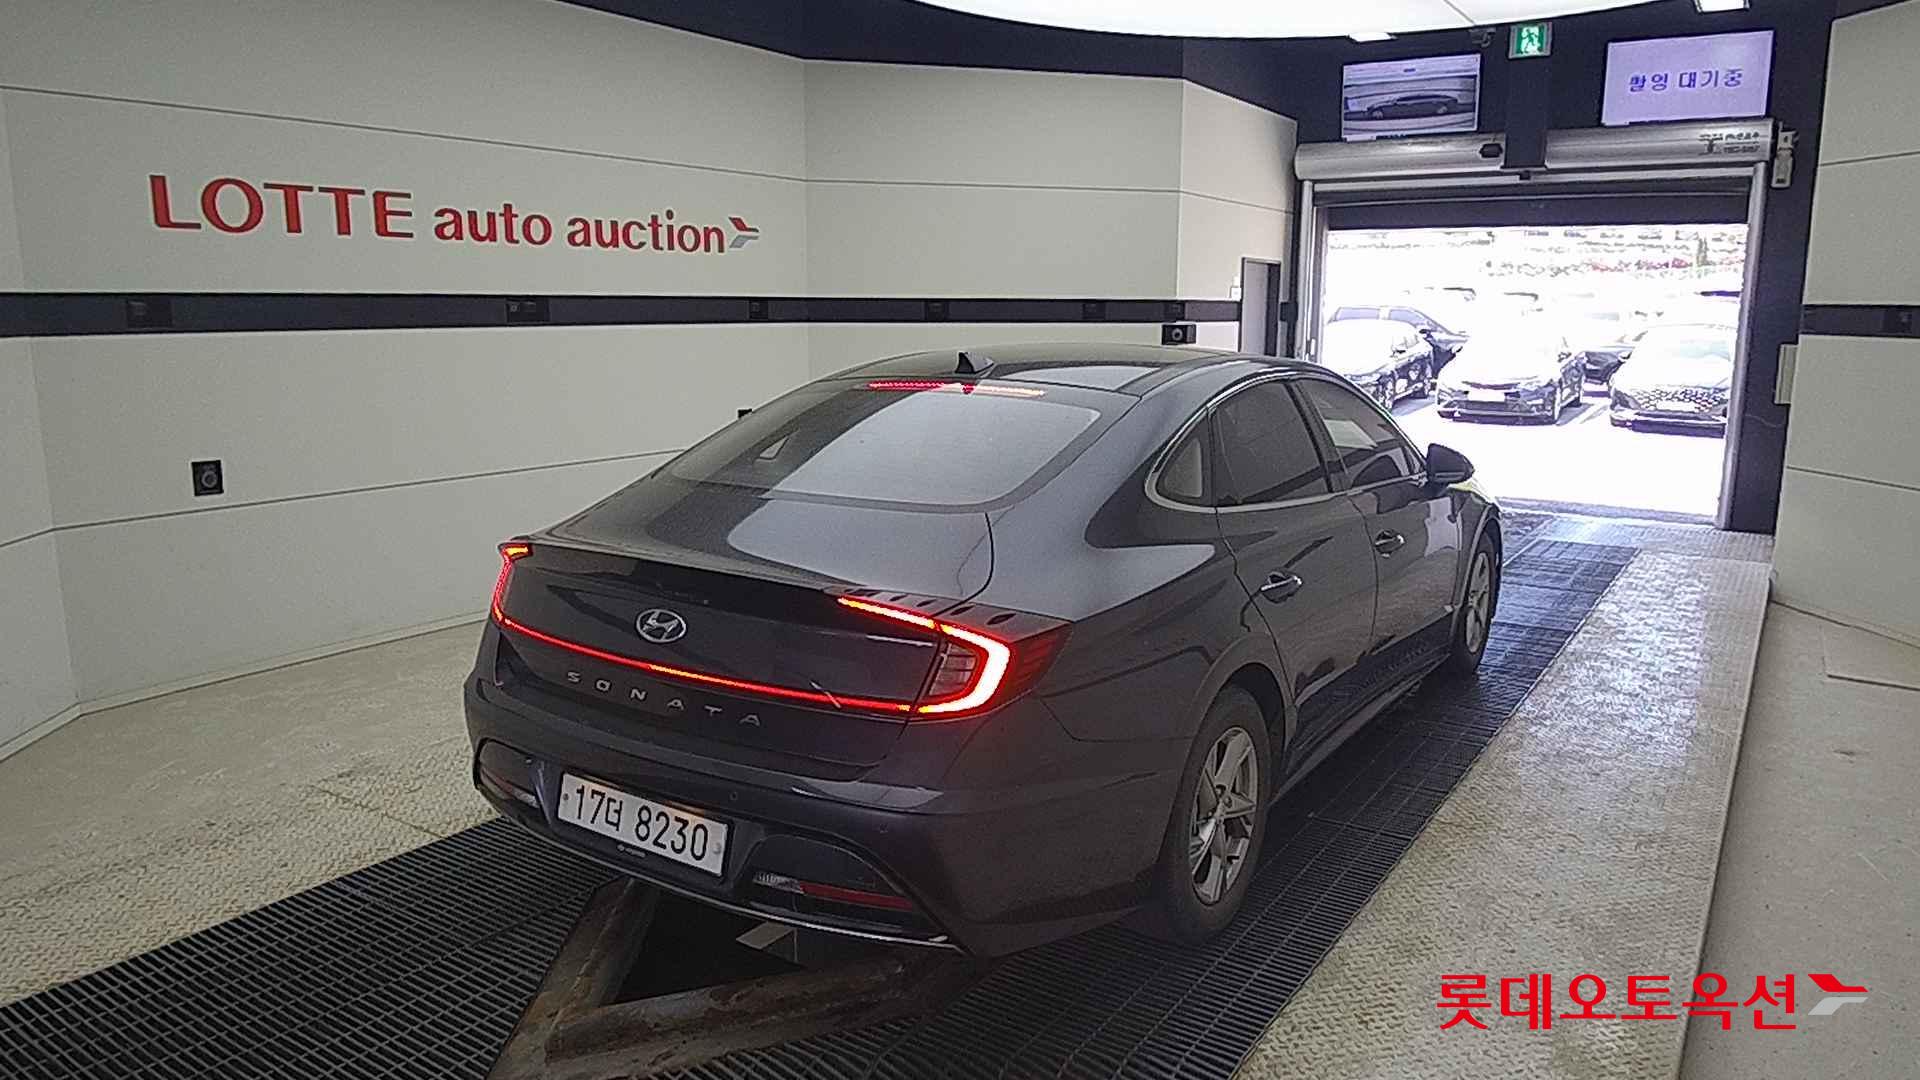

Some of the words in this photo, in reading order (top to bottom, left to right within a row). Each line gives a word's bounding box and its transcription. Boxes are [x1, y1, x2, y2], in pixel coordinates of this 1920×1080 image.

[1678, 68, 1743, 88] 대기중
[149, 174, 415, 239] LOTTE
[433, 203, 552, 246] auto
[566, 209, 725, 254] auction
[567, 671, 761, 727] SONATA
[576, 784, 623, 832] 17더
[635, 805, 709, 861] 8230
